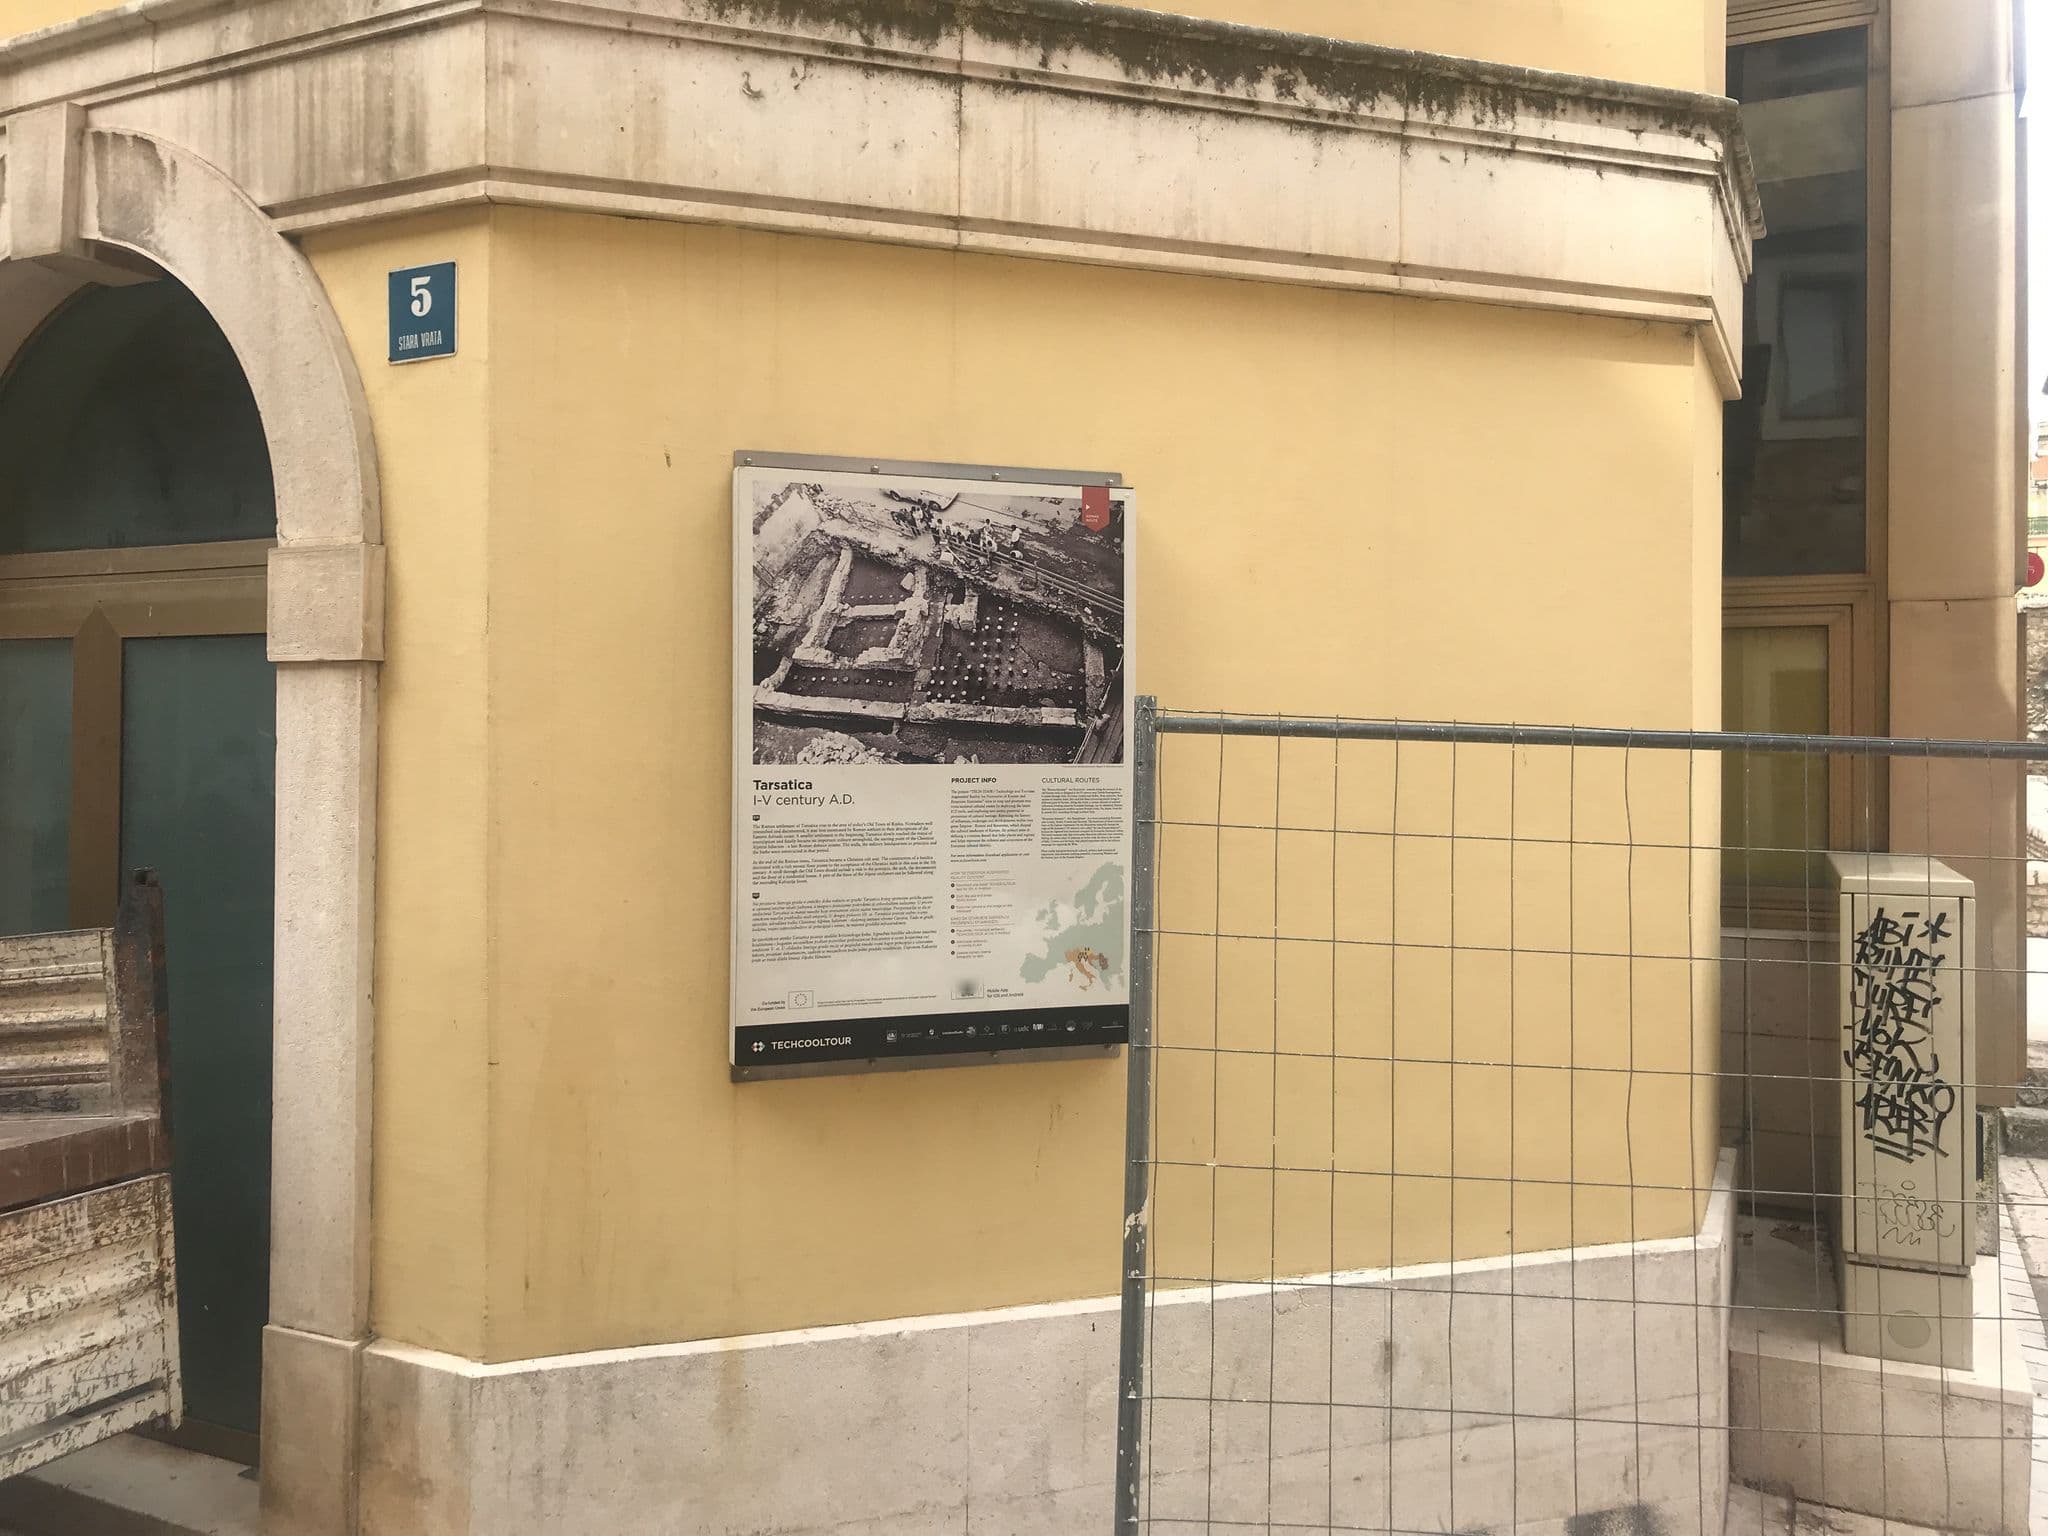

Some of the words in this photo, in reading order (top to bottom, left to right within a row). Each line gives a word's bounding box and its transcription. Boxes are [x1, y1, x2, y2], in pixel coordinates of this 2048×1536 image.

[410, 275, 432, 317] 5
[398, 333, 419, 351] STARA
[421, 330, 442, 347] VRATA
[752, 779, 813, 791] Tarsatica
[753, 794, 772, 806] I-V
[775, 794, 825, 807] century
[829, 793, 855, 805] A.D.
[770, 1036, 852, 1050] TECHCOOLTOUR
